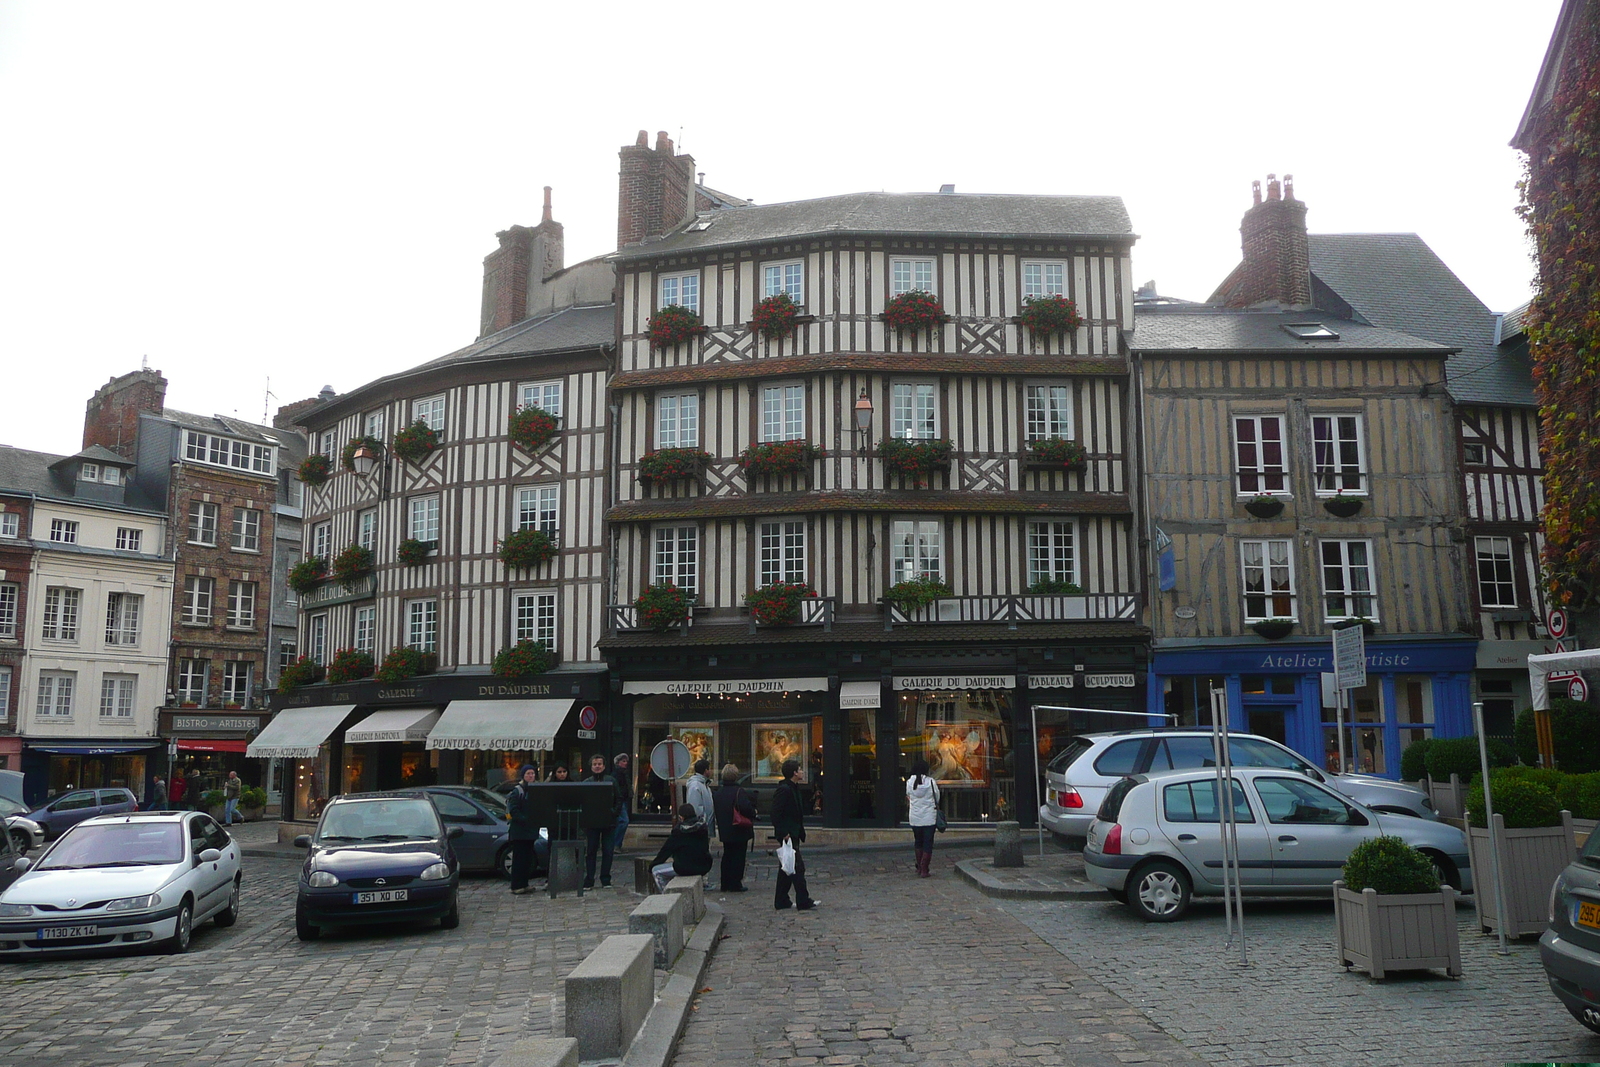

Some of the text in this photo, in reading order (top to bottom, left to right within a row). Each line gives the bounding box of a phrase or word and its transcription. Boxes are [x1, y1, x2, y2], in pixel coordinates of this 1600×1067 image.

[1261, 653, 1325, 668] Atelier
[1496, 656, 1518, 664] Atelier
[902, 677, 1006, 687] GALERIE DU DAUPHIN
[1030, 676, 1072, 686] TABLEAUX
[1086, 675, 1133, 686] SCULPTURES
[378, 685, 551, 699] GALERIE DU DAUPHIN
[667, 681, 784, 693] GALERIE DU DAUPHIN
[176, 719, 208, 728] BISTRO
[218, 719, 256, 728] ARTISTES
[350, 732, 374, 741] GALERIE
[432, 738, 481, 749] PEINTURES
[489, 738, 547, 749] SCULPTURES
[360, 893, 376, 903] 351
[394, 890, 406, 900] 02
[1579, 904, 1596, 923] 295
[45, 926, 95, 939] 7130 ZK 14
